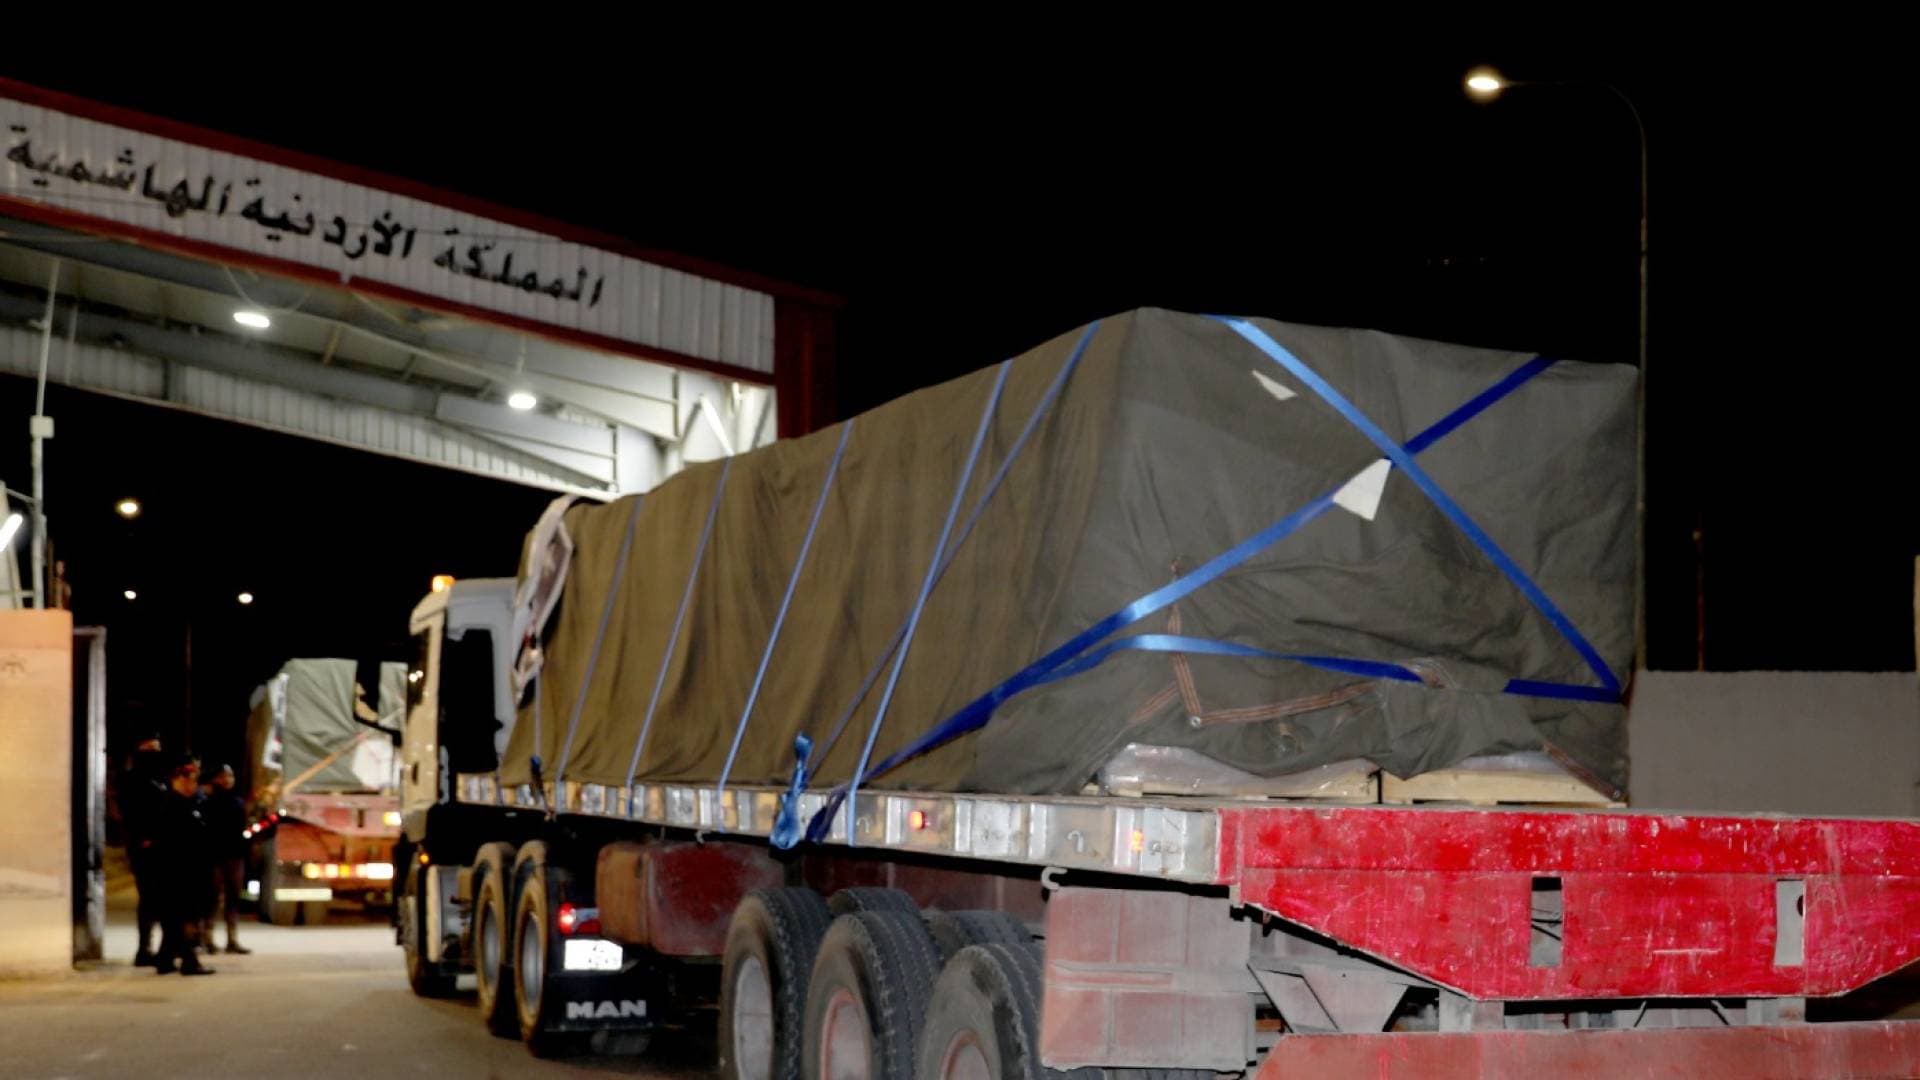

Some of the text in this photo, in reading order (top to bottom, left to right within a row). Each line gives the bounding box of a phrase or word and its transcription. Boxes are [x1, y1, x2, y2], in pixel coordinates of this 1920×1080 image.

[7, 124, 604, 308] المملكة الأردنية الهاشمية
[566, 1000, 647, 1019] MAN
